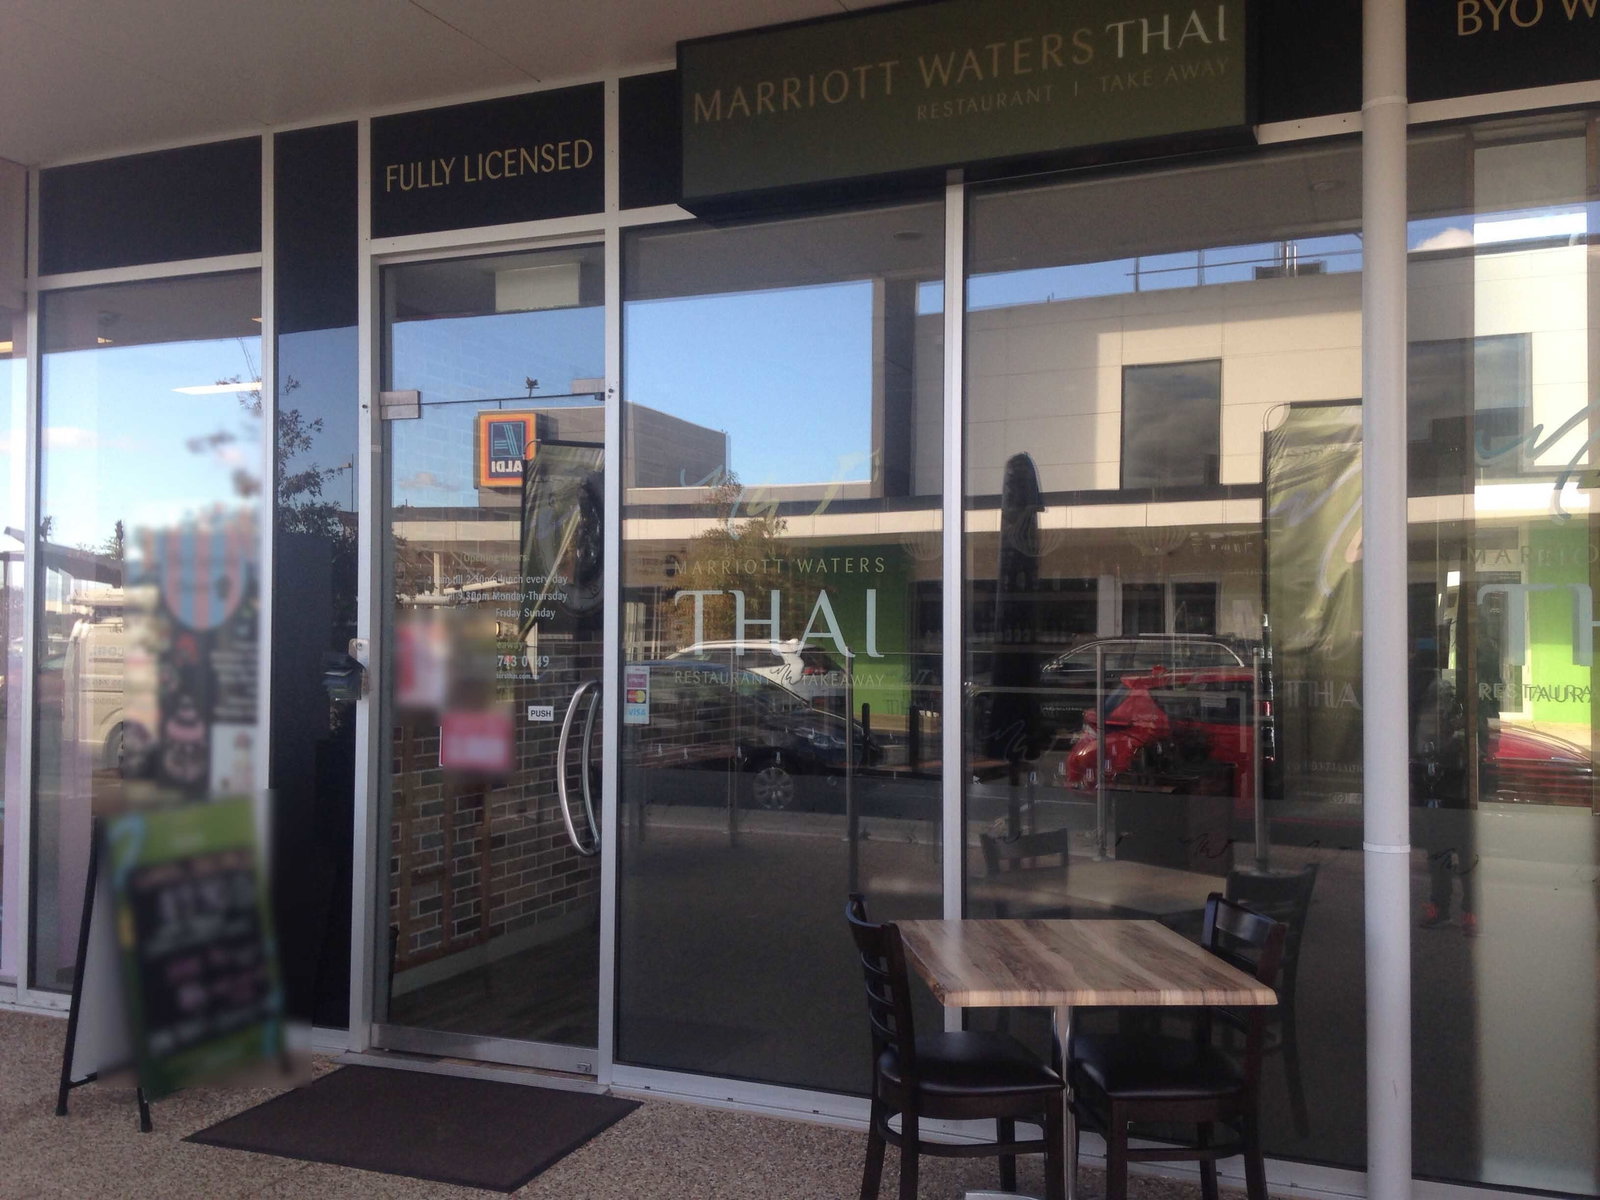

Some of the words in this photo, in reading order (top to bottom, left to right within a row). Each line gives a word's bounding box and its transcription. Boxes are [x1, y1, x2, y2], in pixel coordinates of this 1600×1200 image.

[1457, 0, 1544, 36] BYO
[694, 60, 899, 124] MARRIOTT
[917, 28, 1094, 89] WATERS
[1105, 4, 1228, 58] THAI
[916, 84, 1053, 121] RESTAURANT
[1099, 69, 1152, 92] TAKE
[1165, 57, 1229, 83] AWAY
[386, 157, 456, 192] FULLY
[463, 139, 593, 183] LICENSED
[674, 558, 785, 575] MARRIOTT
[796, 556, 886, 574] WATERS
[551, 573, 569, 586] day
[496, 608, 521, 618] Friday
[524, 607, 556, 620] Sunday
[674, 588, 885, 658] THAI
[674, 670, 771, 686] RESTAURANT
[801, 672, 885, 688] TAKEAWAY
[530, 709, 551, 717] PUSH
